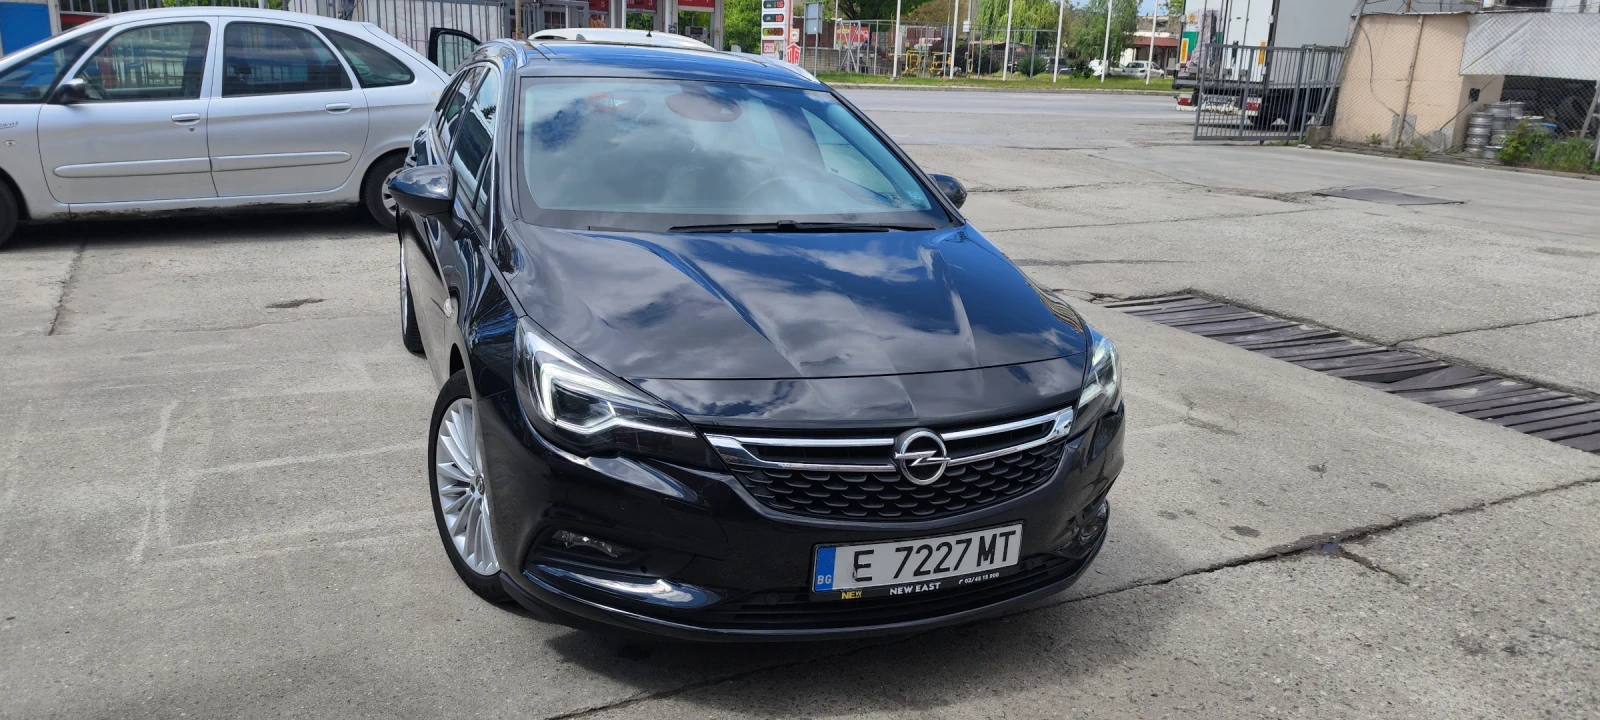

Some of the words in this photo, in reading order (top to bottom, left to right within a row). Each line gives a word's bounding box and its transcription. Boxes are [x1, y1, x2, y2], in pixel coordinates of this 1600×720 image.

[853, 549, 874, 583] E
[892, 538, 973, 579] 7227
[976, 530, 1016, 567] MT
[817, 574, 832, 585] BG
[841, 590, 862, 599] NEW
[889, 585, 913, 596] NEW
[915, 582, 941, 593] EAST
